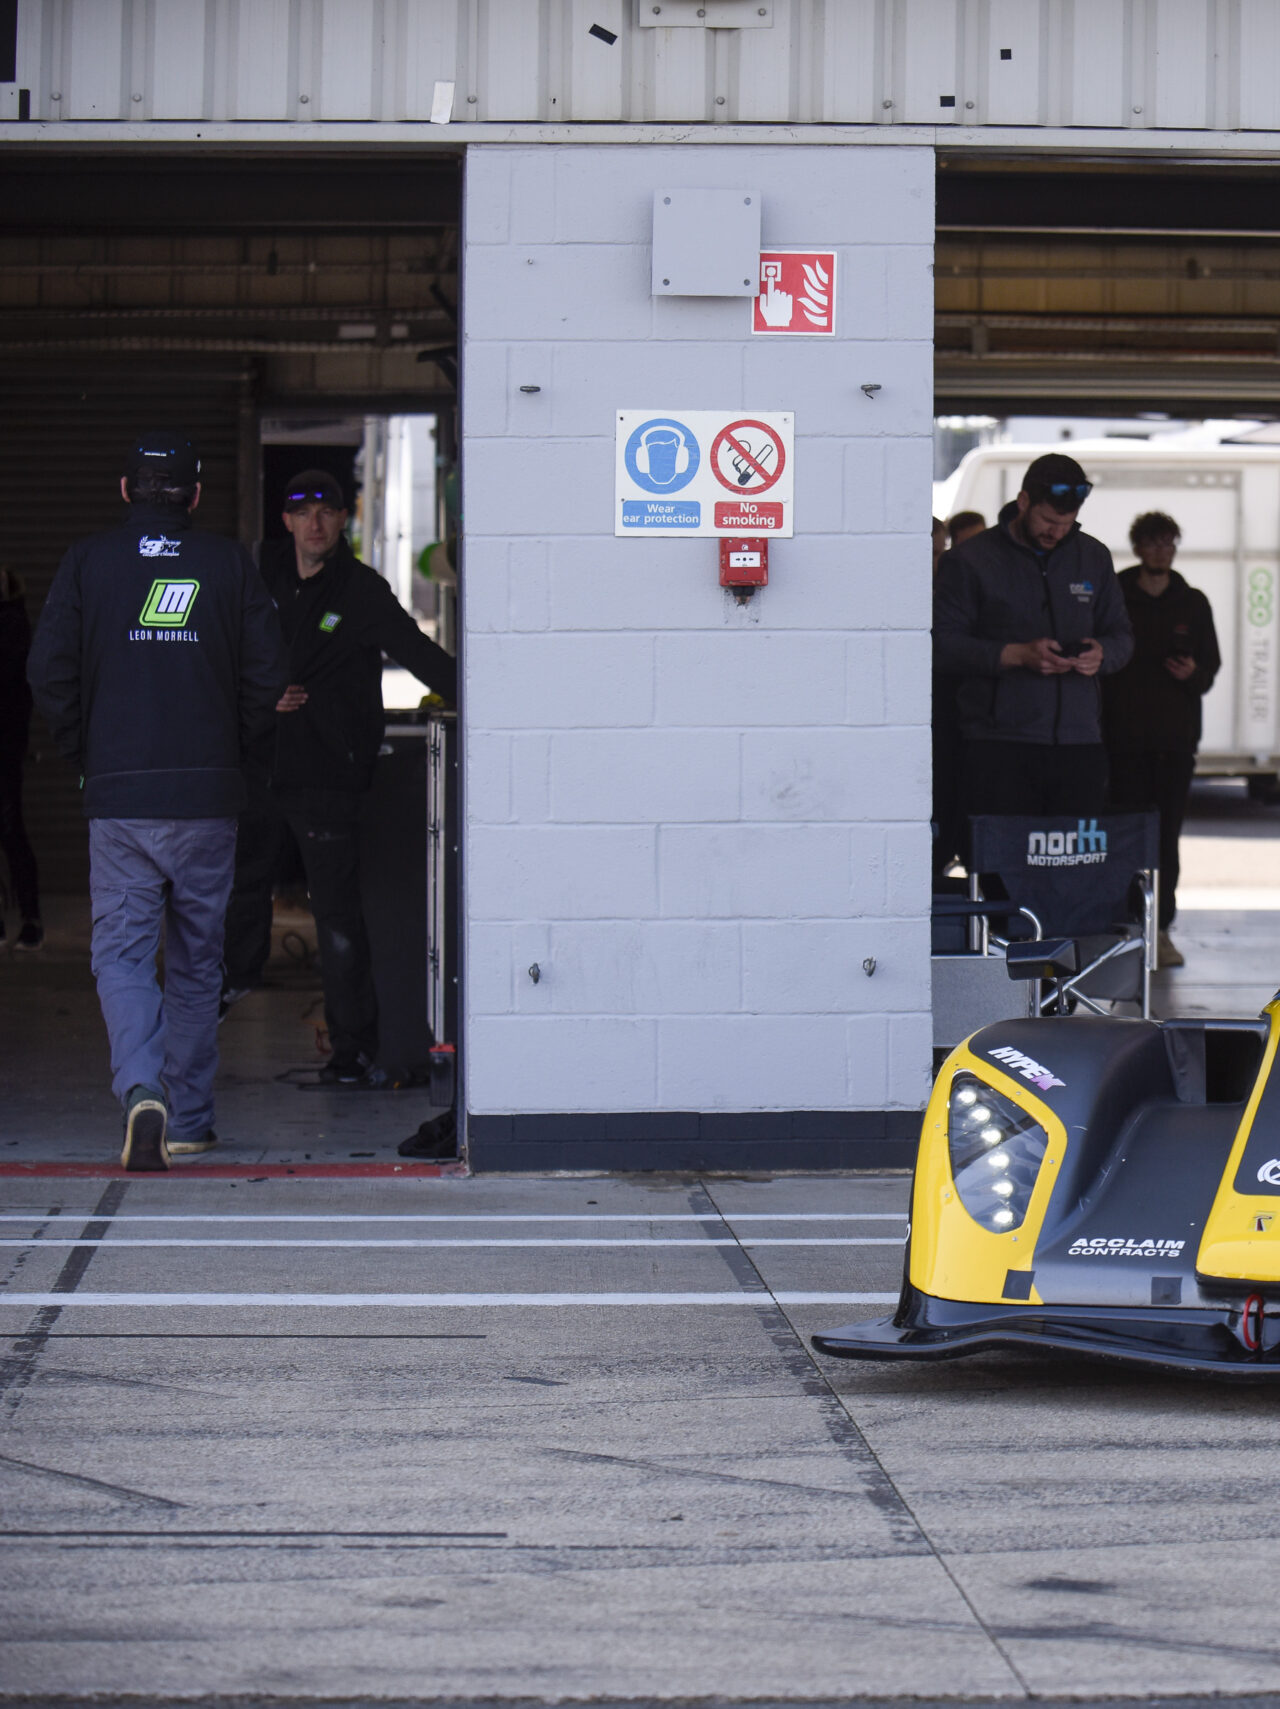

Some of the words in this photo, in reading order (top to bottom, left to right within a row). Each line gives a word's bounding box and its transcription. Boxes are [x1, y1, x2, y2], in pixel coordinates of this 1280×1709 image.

[647, 504, 675, 513] Wear
[740, 503, 758, 513] No
[623, 515, 639, 523] ear
[644, 514, 699, 525] protection
[722, 514, 776, 528] smoking
[129, 630, 153, 641] LEON
[156, 630, 199, 642] MORRELL
[1028, 819, 1107, 855] north
[1027, 852, 1107, 866] MOTORSPORT
[1071, 1238, 1186, 1249] ACCLAIM
[1068, 1247, 1180, 1258] CONTRACTS
